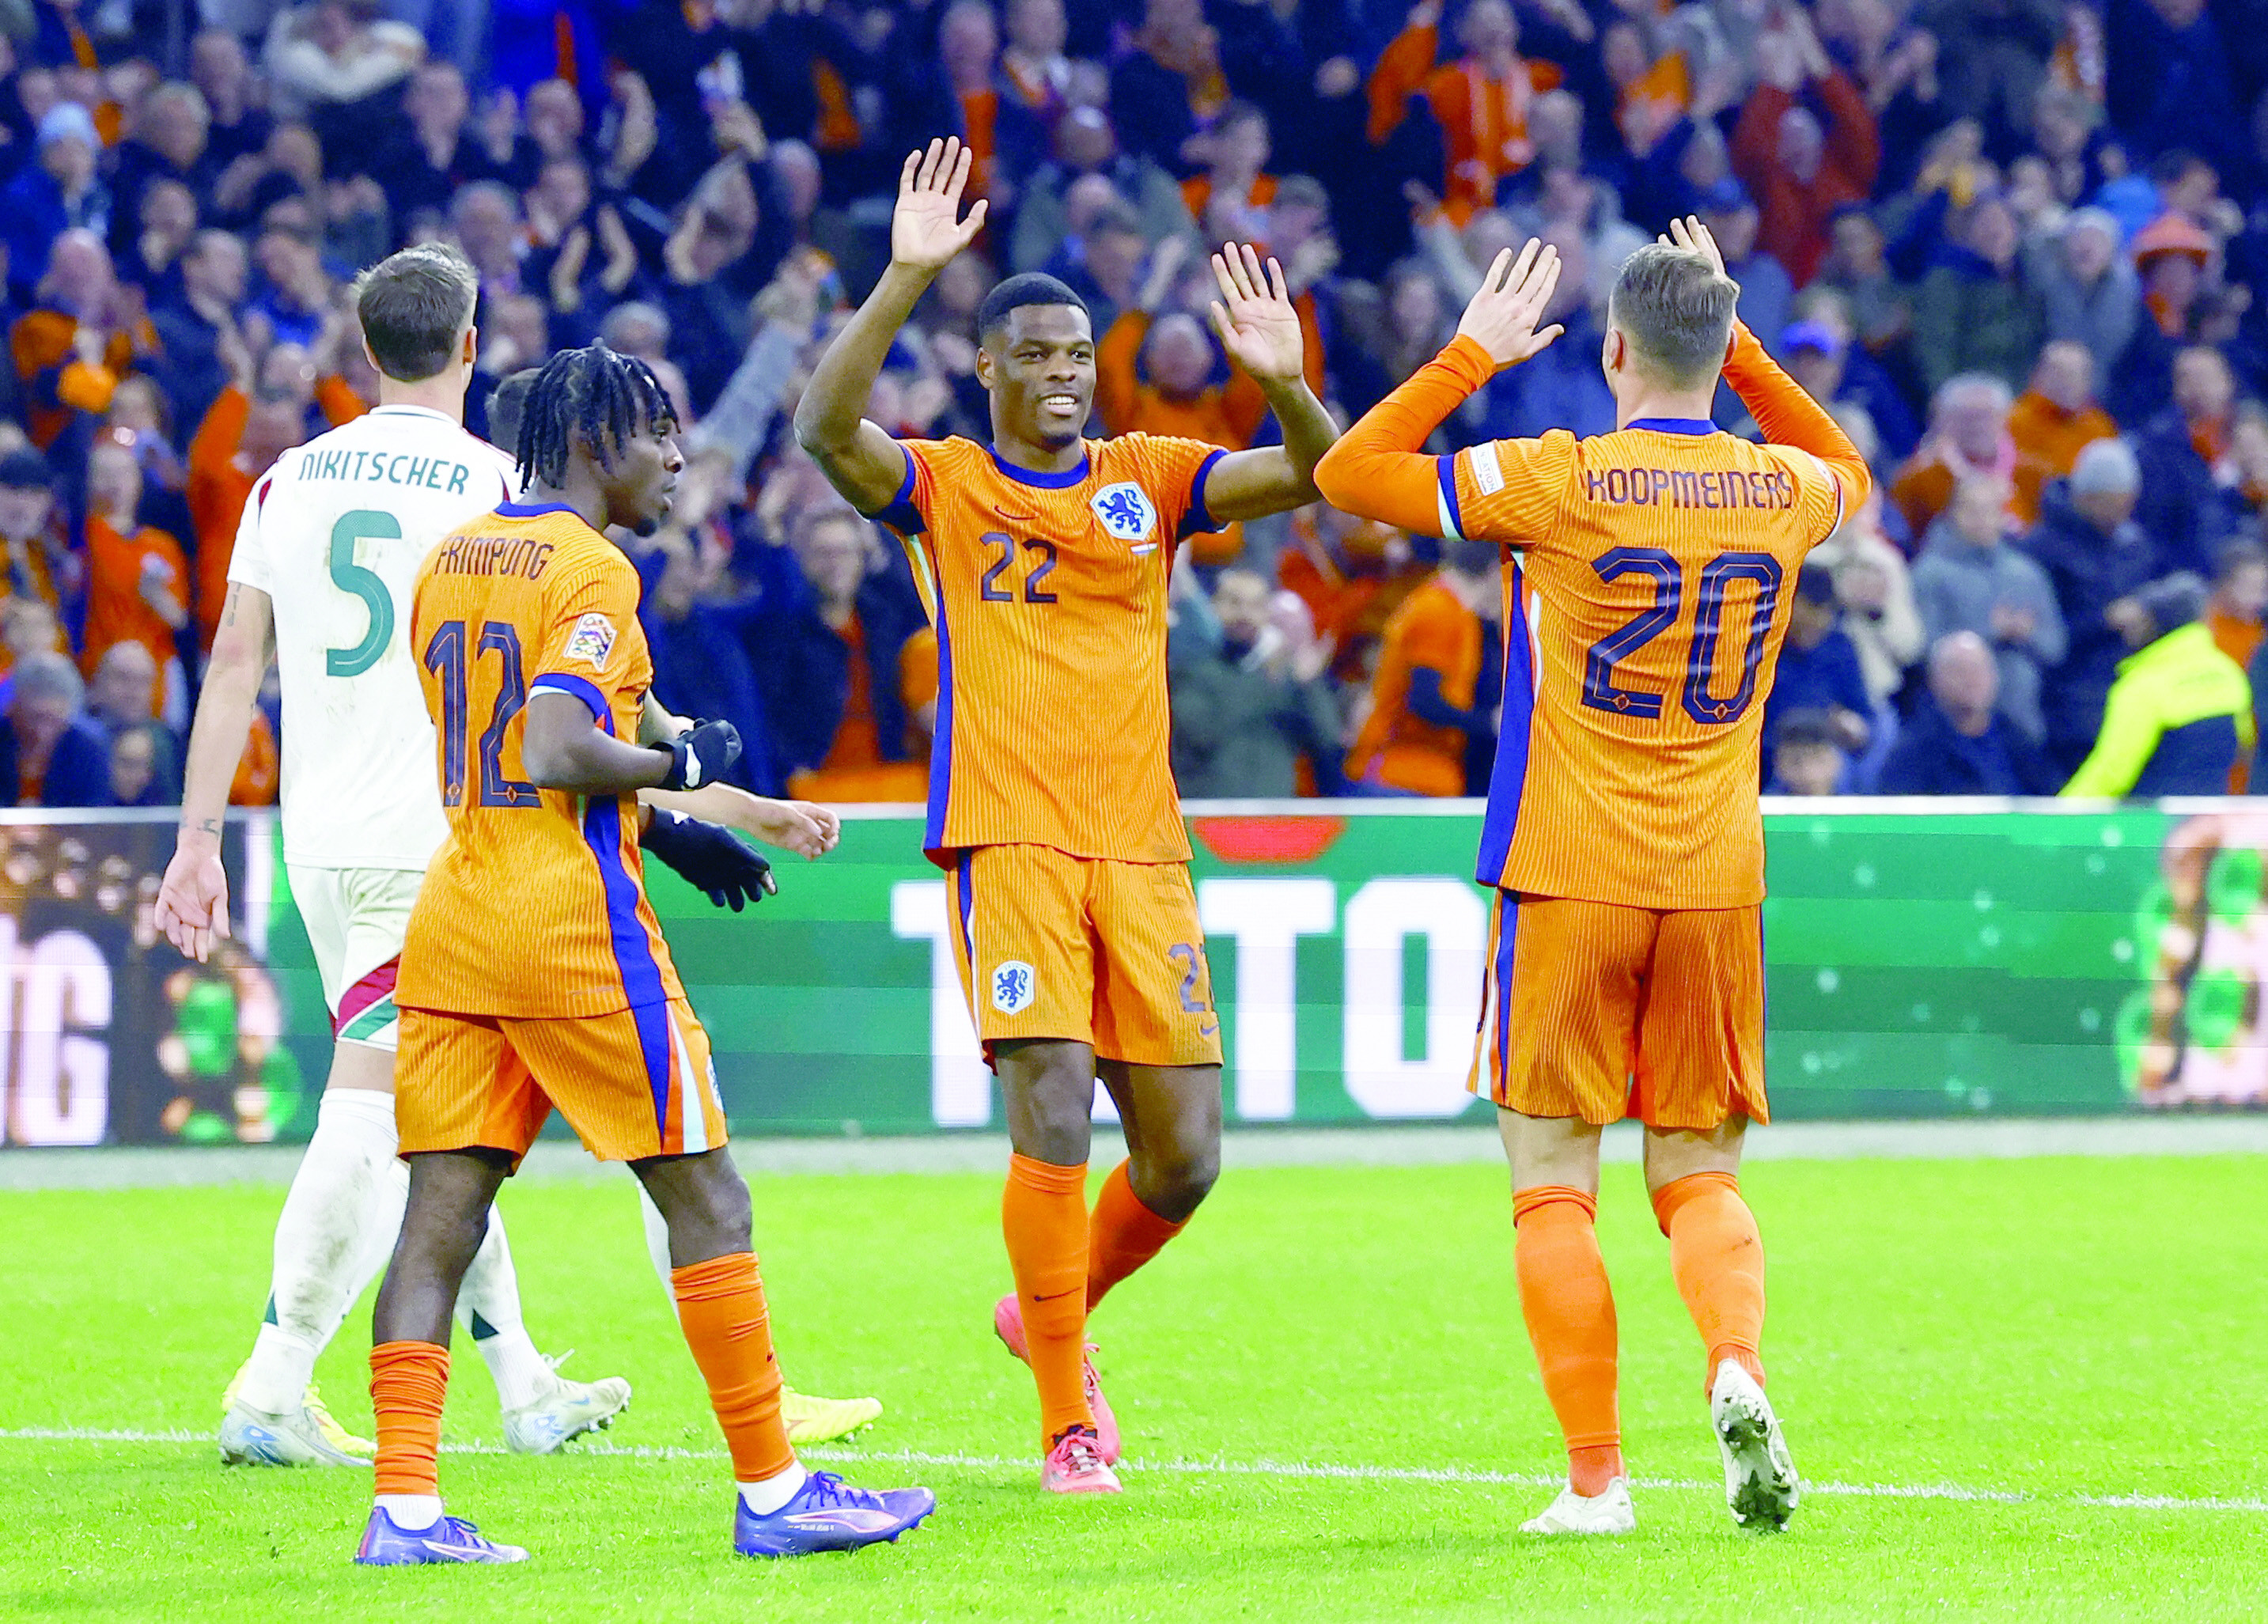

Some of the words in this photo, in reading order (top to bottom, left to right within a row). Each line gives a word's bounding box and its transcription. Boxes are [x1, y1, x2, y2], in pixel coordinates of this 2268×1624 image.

[298, 450, 469, 495] NIKITSCHER
[1587, 468, 1792, 509] KOOPMEINERS
[327, 509, 402, 677] 5
[434, 536, 555, 580] FRIMPONG
[979, 532, 1057, 603] 22
[1581, 546, 1782, 724] 20
[424, 621, 542, 808] 12
